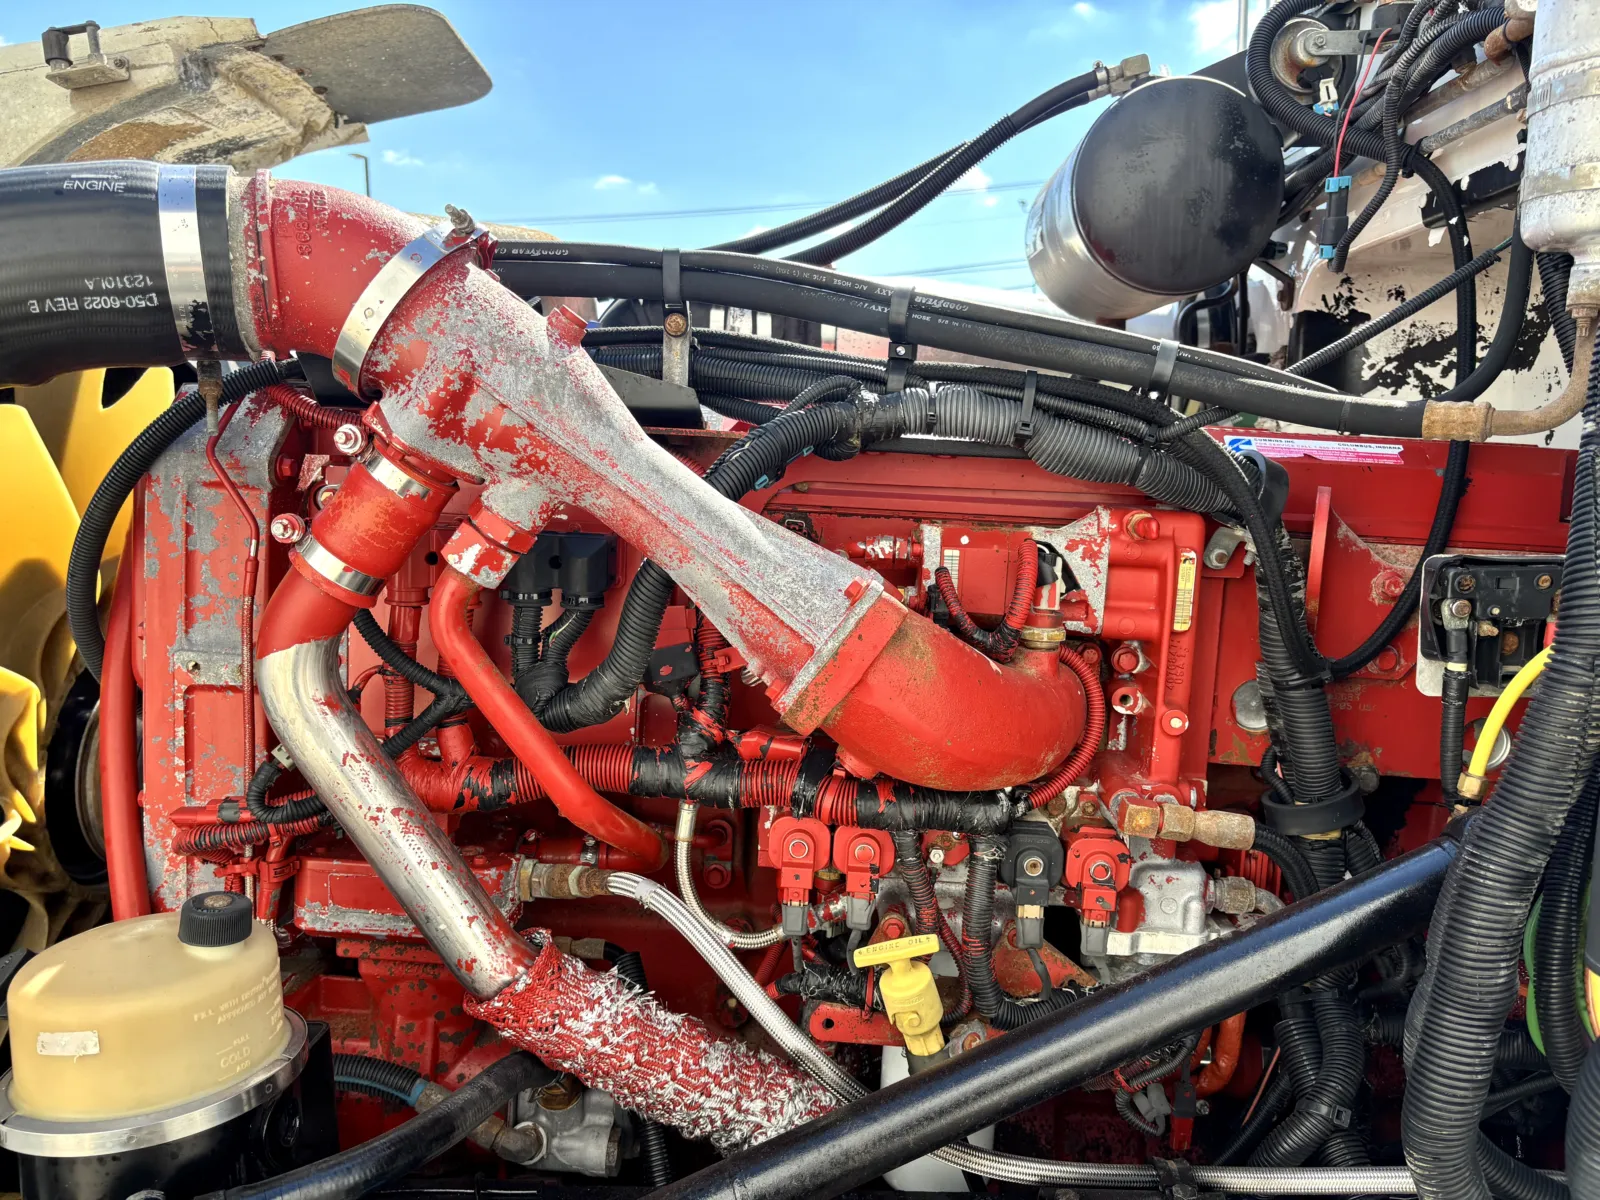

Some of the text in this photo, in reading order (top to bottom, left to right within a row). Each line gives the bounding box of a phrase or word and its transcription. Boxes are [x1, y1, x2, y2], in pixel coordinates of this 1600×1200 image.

[63, 180, 127, 193] ENGINE
[511, 247, 569, 257] GOODYEAR
[833, 278, 852, 288] HOSE
[45, 297, 79, 312] REV
[84, 292, 160, 310] D50-6022
[914, 295, 969, 312] GOODYEAR
[911, 313, 932, 322] HOSE
[866, 937, 924, 954] ENGINE OIL
[233, 1033, 250, 1046] FULL
[220, 1046, 251, 1068] COLD
[236, 1059, 251, 1073] ADD
